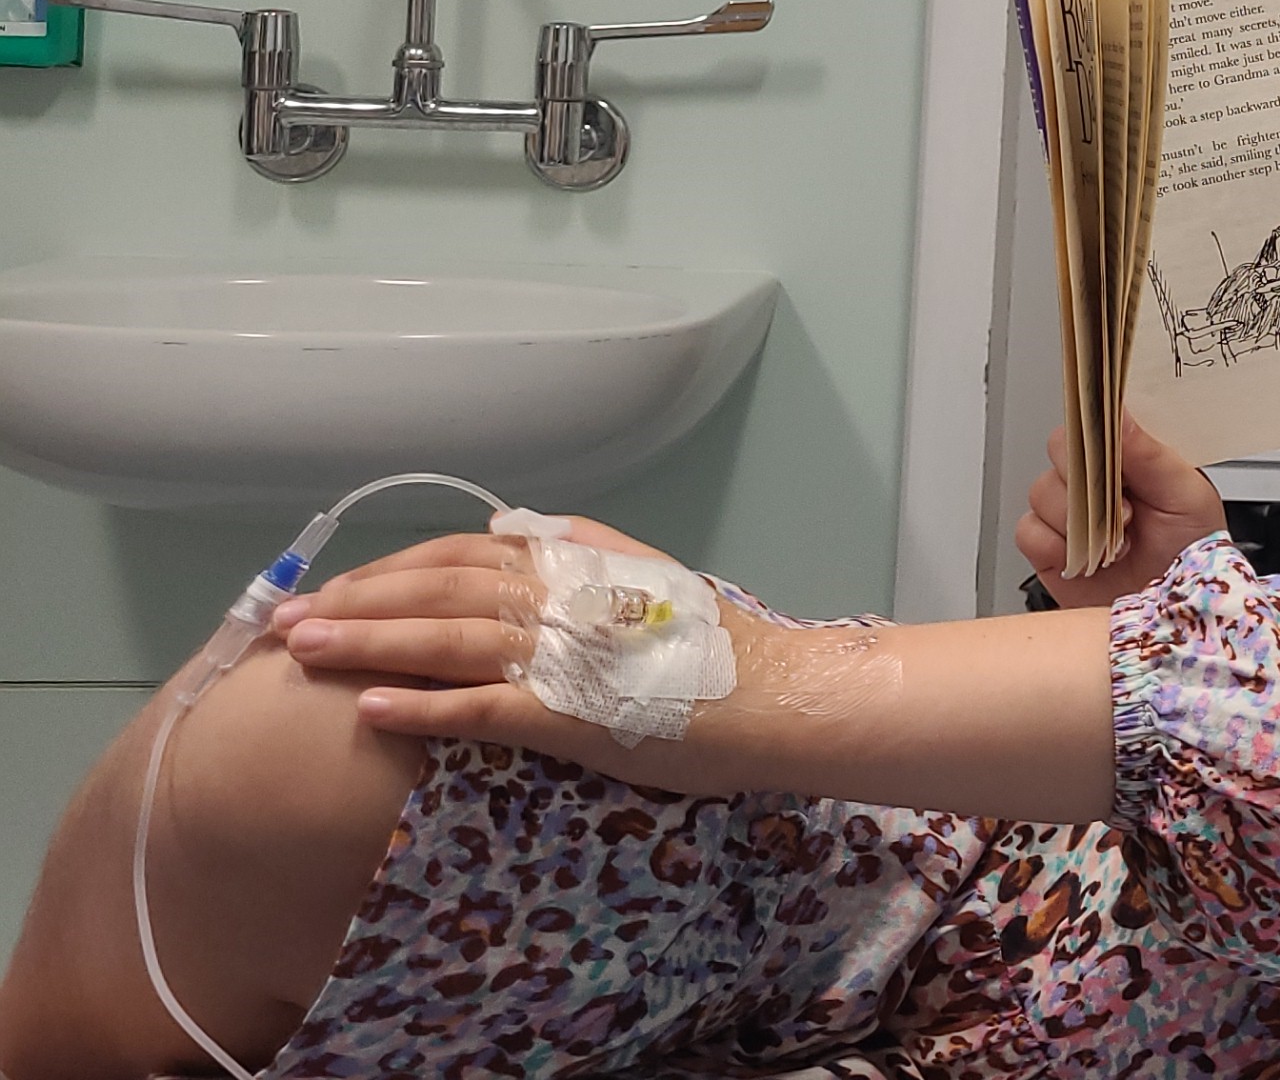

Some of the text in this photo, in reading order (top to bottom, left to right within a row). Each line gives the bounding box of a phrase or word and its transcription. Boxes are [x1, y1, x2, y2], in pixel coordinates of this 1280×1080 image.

[1194, 11, 1226, 24] move
[1228, 2, 1264, 18] either.
[1166, 32, 1196, 48] great
[1201, 26, 1234, 42] many
[1169, 44, 1211, 61] smiled.
[1215, 41, 1225, 53] It
[1229, 39, 1252, 50] was
[1255, 37, 1263, 46] a
[1170, 61, 1206, 80] might
[1207, 54, 1240, 70] make
[1240, 50, 1265, 67] just
[1167, 79, 1195, 94] here
[1197, 78, 1210, 88] to
[1213, 65, 1269, 85] Grandma
[1162, 114, 1187, 130] ook
[1199, 109, 1224, 123] step
[1211, 138, 1227, 151] be
[1158, 165, 1174, 178] a,'
[1177, 161, 1198, 174] she
[1199, 154, 1227, 171] said,
[1228, 146, 1272, 165] smiling
[1171, 176, 1198, 191] took
[1200, 167, 1246, 185] another
[1248, 164, 1272, 179] step
